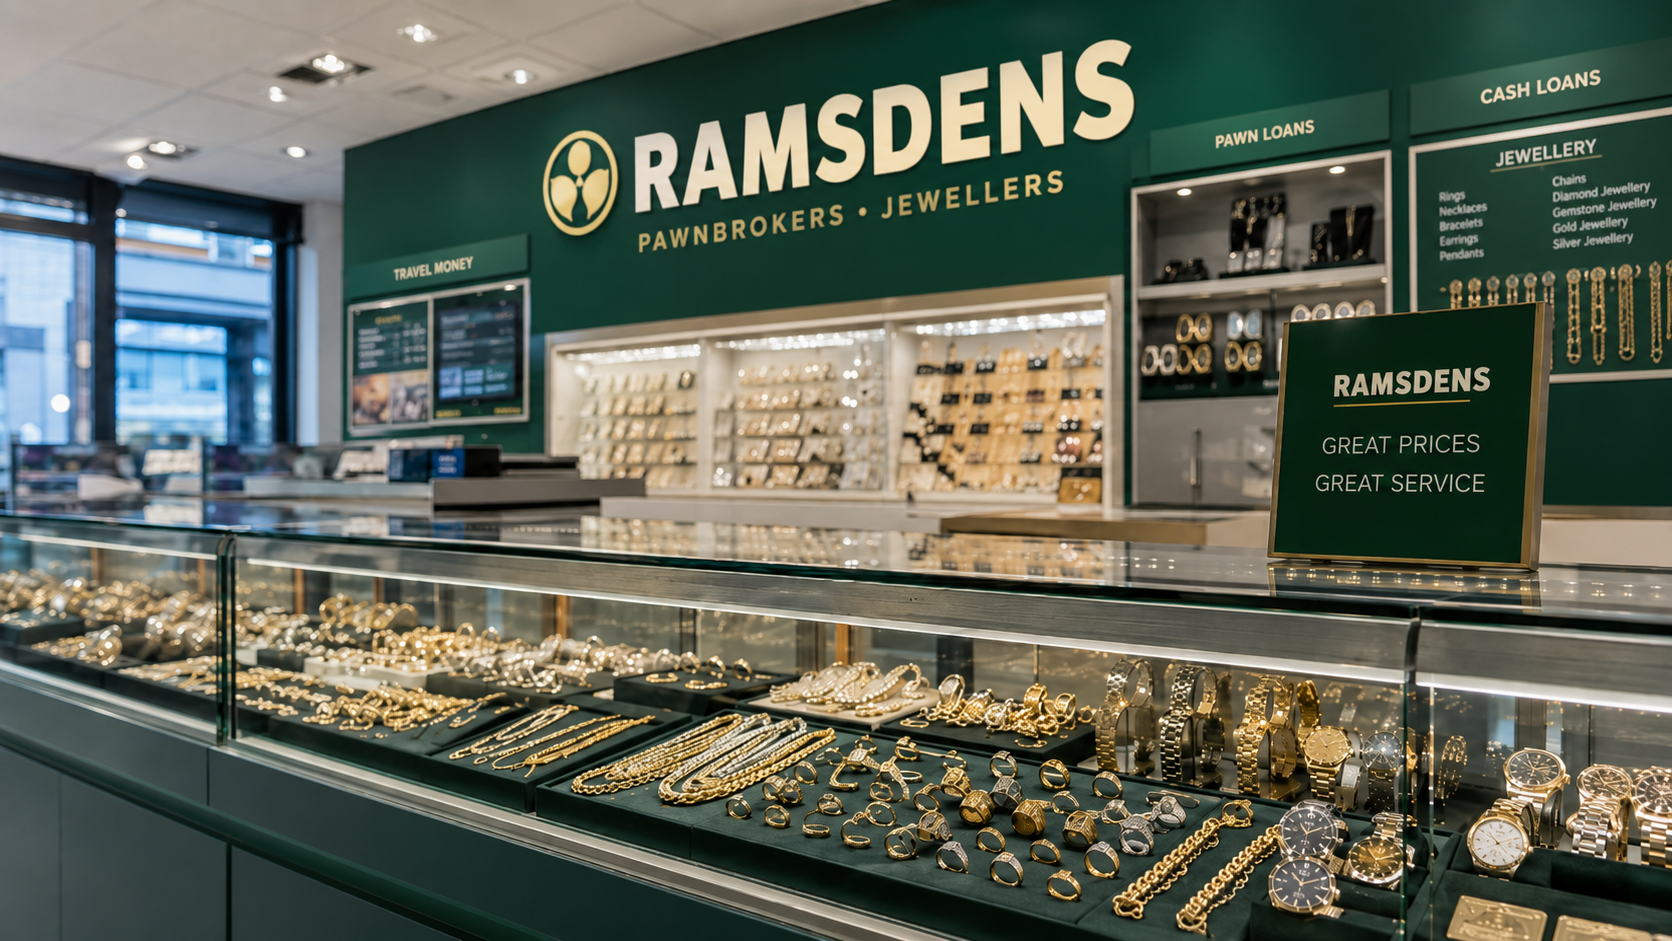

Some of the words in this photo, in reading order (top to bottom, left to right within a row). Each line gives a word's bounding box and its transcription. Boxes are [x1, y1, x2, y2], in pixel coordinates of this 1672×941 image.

[1480, 82, 1530, 104] CASH
[1536, 69, 1601, 95] LOANS
[634, 39, 1136, 214] RAMSDENS
[1215, 129, 1258, 148] PAWN
[1262, 119, 1315, 141] LOANS
[1495, 138, 1597, 167] JEWELLERY
[1552, 174, 1587, 187] Chains
[1439, 190, 1466, 203] Rings
[1552, 187, 1598, 203] Diamond
[1600, 181, 1651, 198] Jewellery
[638, 203, 845, 253] PAWNBROKERS
[880, 170, 1064, 220] JEWELLERS
[1439, 202, 1488, 217] Necklaces
[1552, 203, 1605, 218] Gemstone
[1607, 196, 1657, 213] Jewellery
[1439, 217, 1483, 232] Bracelets
[1552, 221, 1577, 234] Gold
[1579, 216, 1629, 232] Jewellery
[1439, 233, 1479, 247] Earrings
[1552, 236, 1582, 250] Silver
[1583, 231, 1634, 247] Jewellery
[1439, 248, 1485, 261] Pendants
[393, 263, 432, 281] TRAVEL
[434, 256, 474, 275] MONEY
[1333, 366, 1491, 398] RAMSDENS
[1322, 435, 1392, 455] GREAT
[1399, 434, 1480, 454] PRICES
[1315, 474, 1384, 492] GREAT
[1391, 473, 1486, 493] SERVICE
